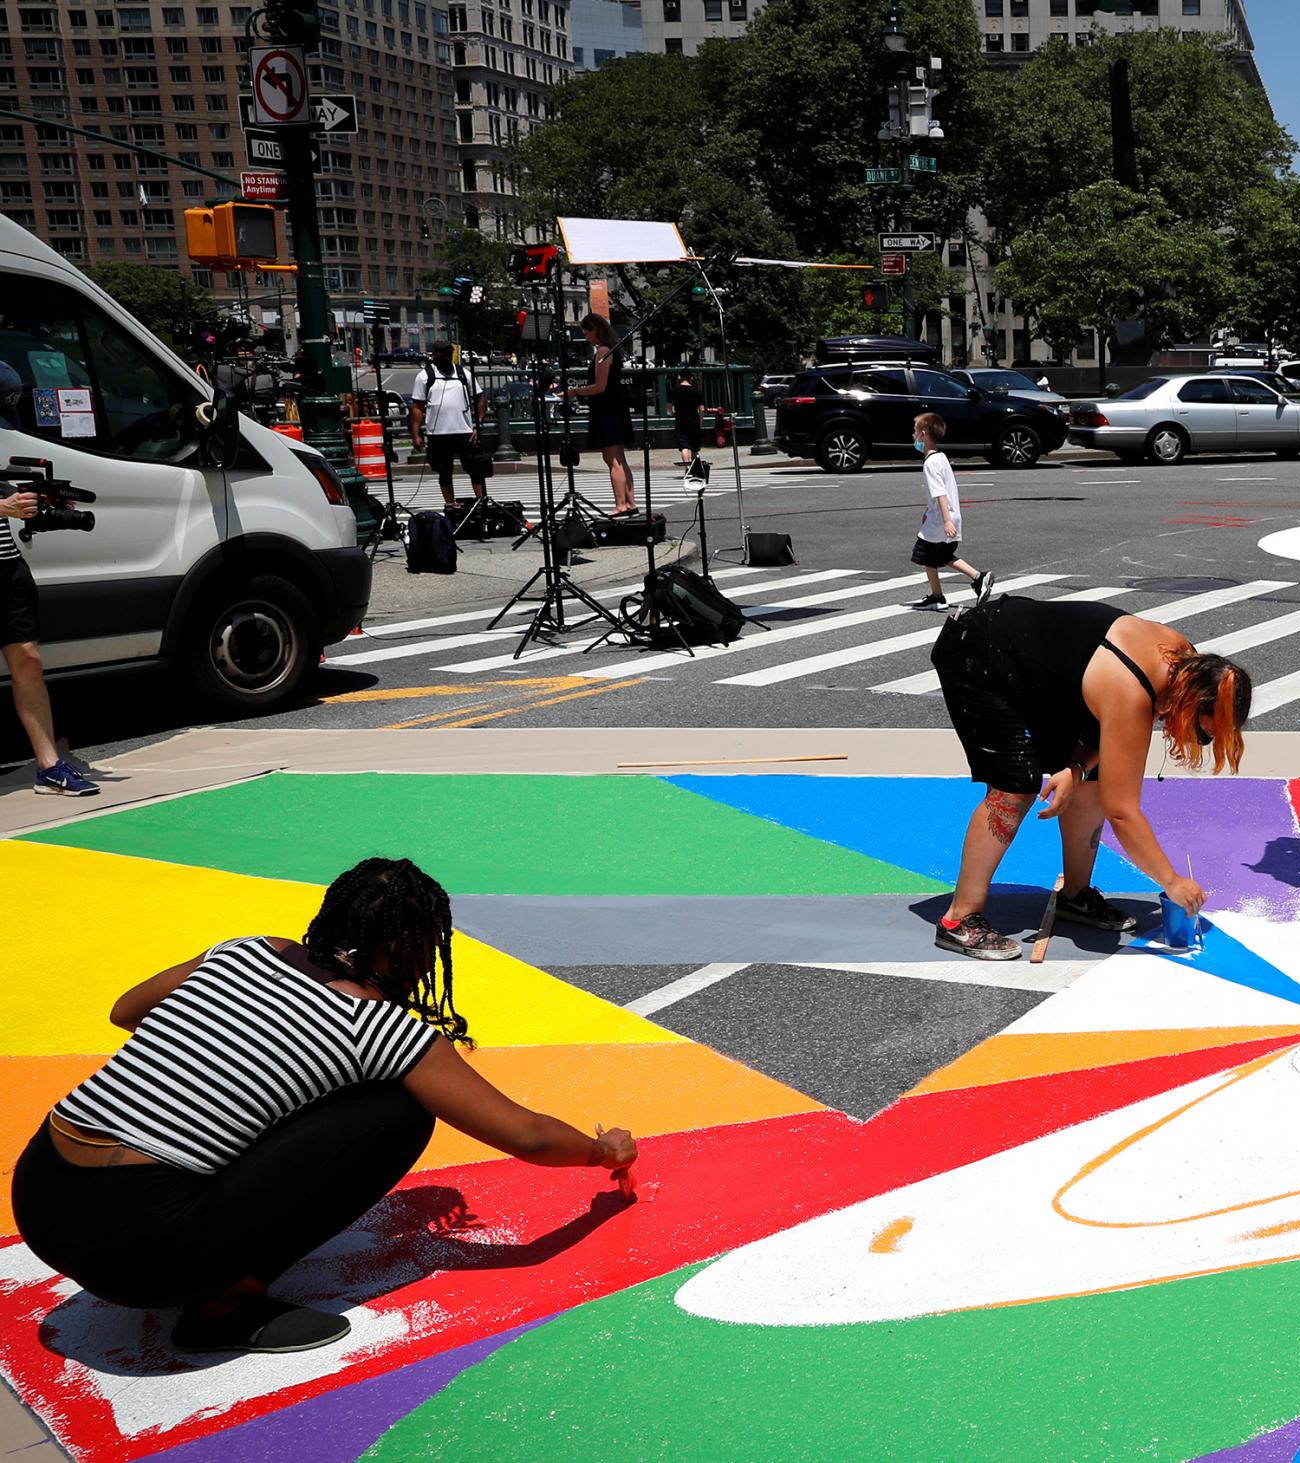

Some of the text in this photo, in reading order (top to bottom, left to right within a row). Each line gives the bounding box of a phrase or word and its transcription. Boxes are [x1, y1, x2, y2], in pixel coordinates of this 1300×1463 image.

[258, 143, 280, 158] ONE
[245, 177, 288, 185] NO STANDIN
[866, 171, 888, 182] DUANE
[246, 186, 276, 195] Anytime
[887, 238, 926, 247] ONE WAY
